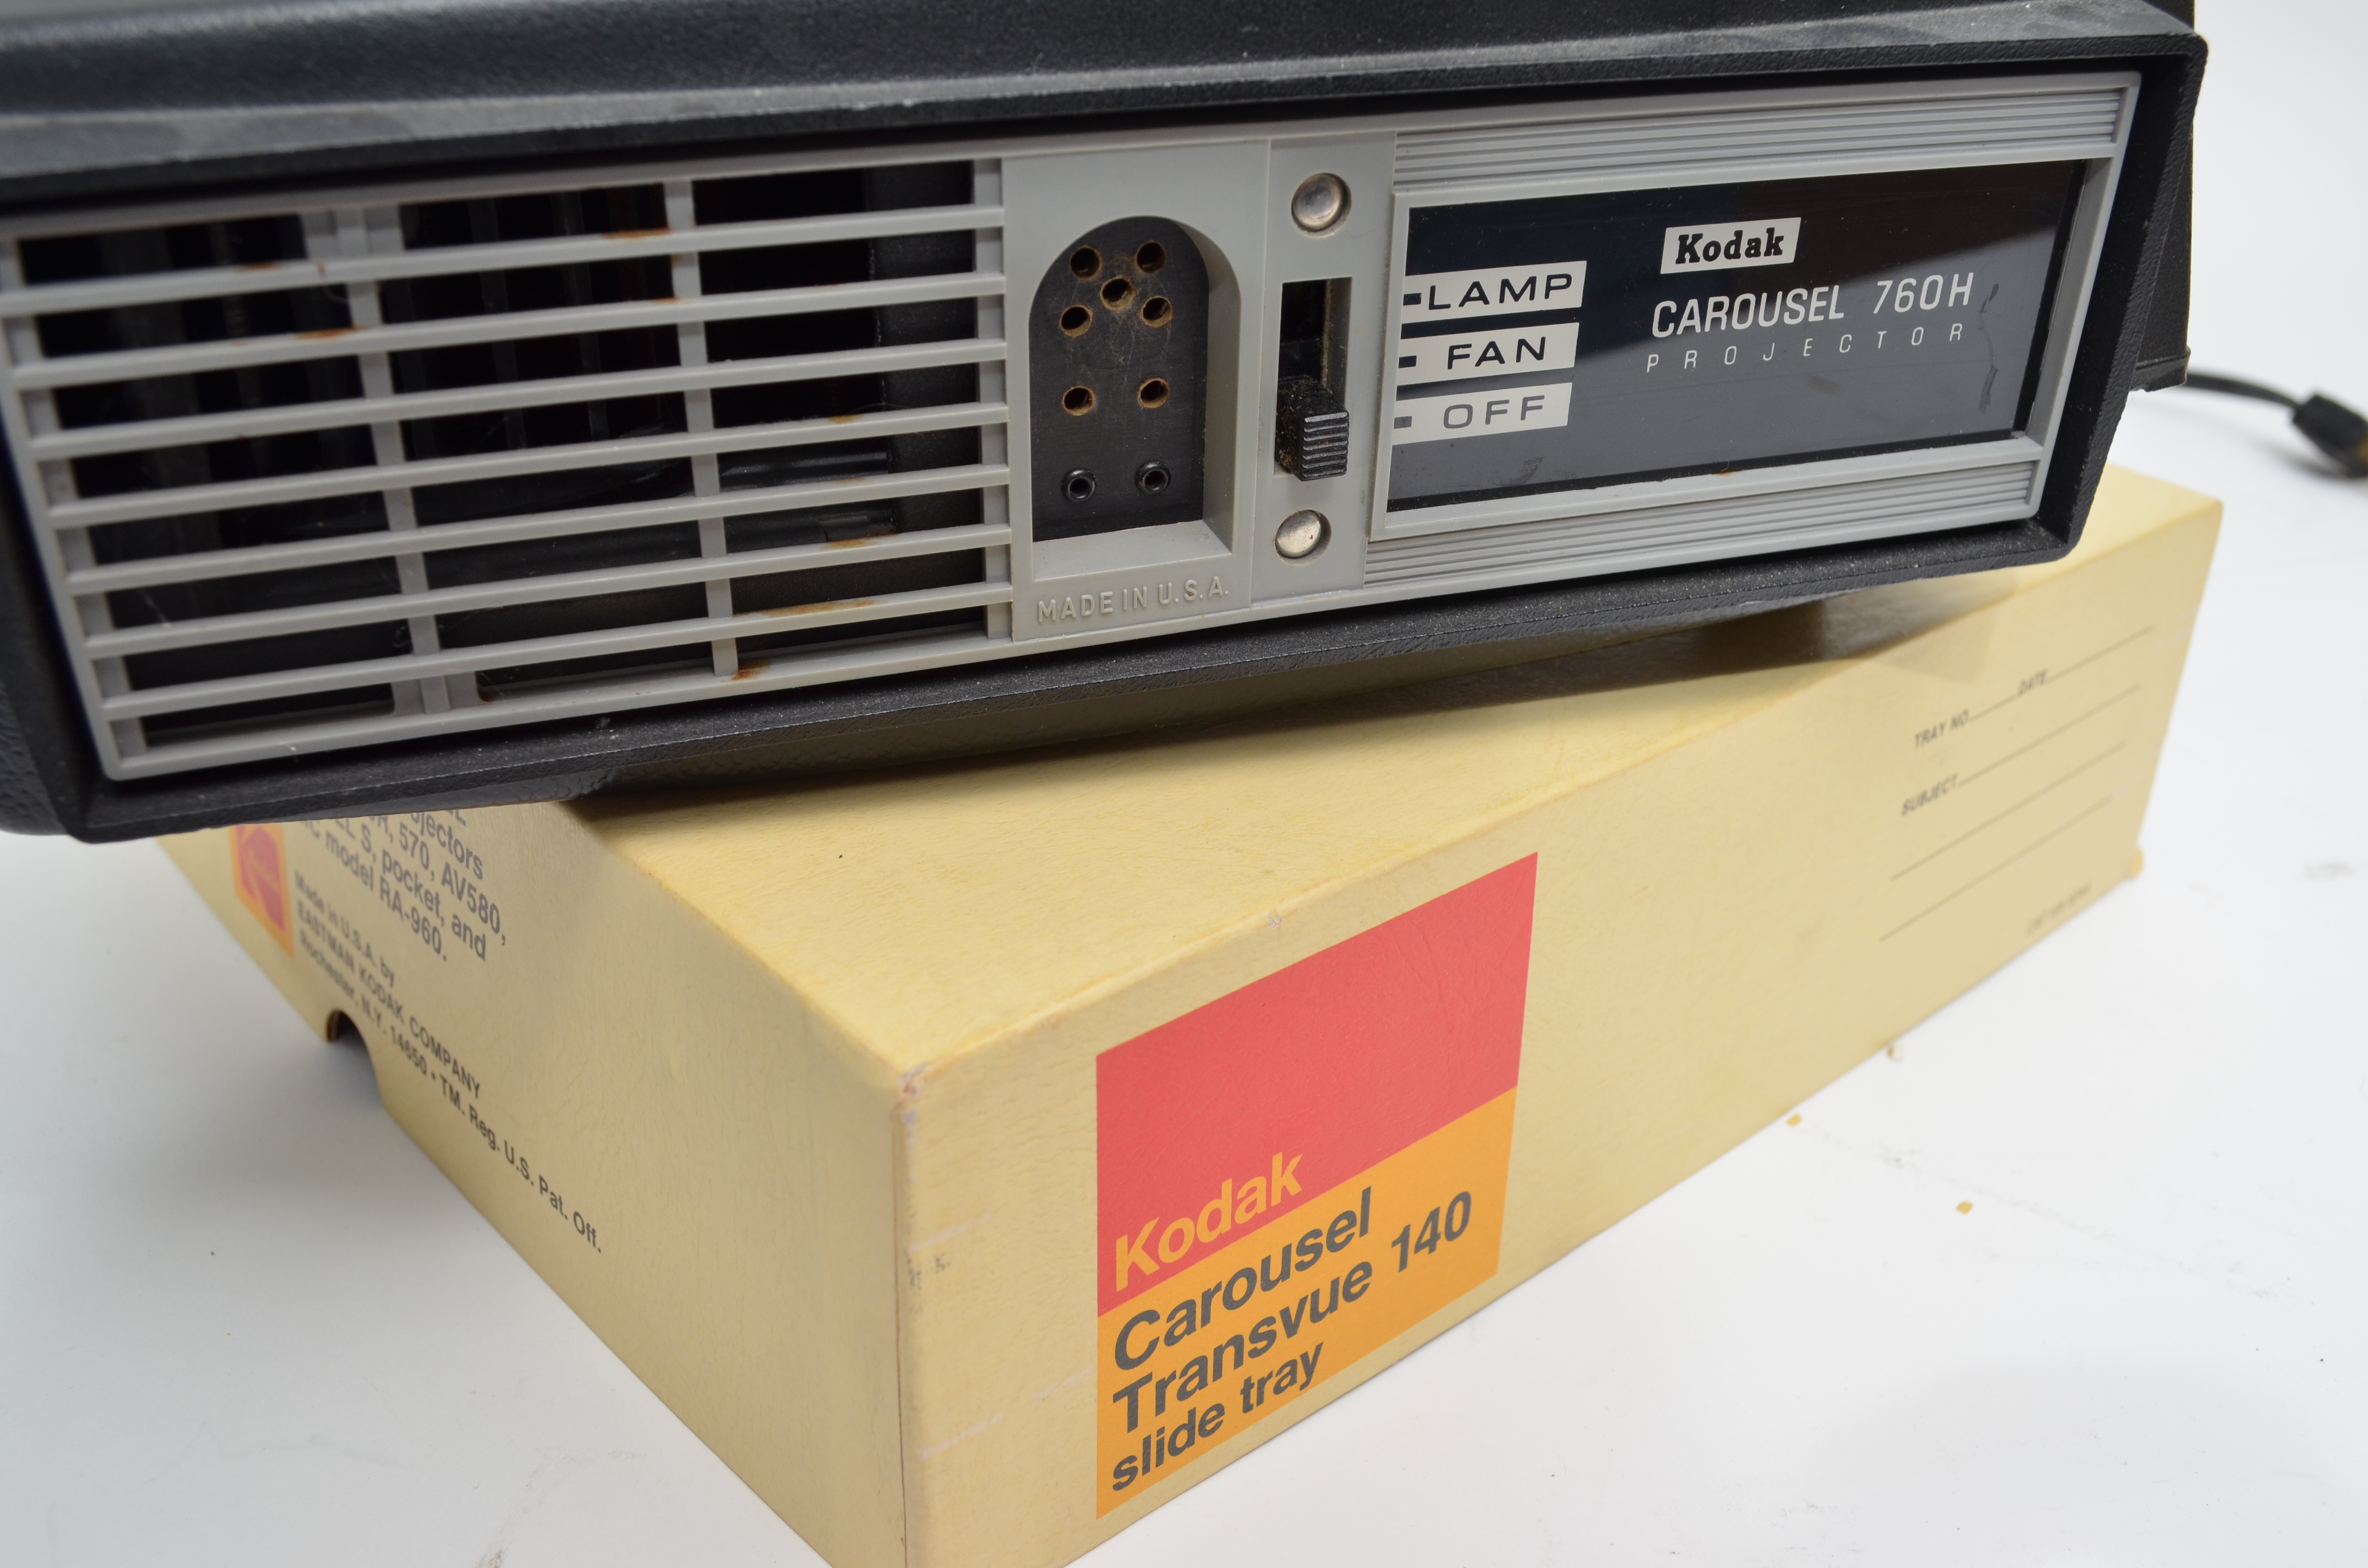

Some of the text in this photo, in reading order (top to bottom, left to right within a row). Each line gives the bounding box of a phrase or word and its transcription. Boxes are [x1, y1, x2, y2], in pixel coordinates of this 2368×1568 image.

[1675, 227, 1786, 265] Kodak
[1428, 273, 1574, 311] LAMP
[1652, 272, 1973, 338] CAROUSEL 760H
[1446, 335, 1547, 370] FAN
[1646, 322, 1963, 373] PROJECTOR
[1443, 394, 1546, 429] OFF
[1038, 576, 1229, 623] MADE IN U.S.A.
[1914, 720, 1946, 749] TRAY
[1901, 772, 1958, 817] SUBJECT
[325, 830, 374, 891] model
[382, 848, 445, 927] pocket,
[451, 914, 486, 962] and
[441, 862, 506, 946] AV580,
[297, 899, 481, 1099] EASTMAN KODAK COMPANY
[469, 1104, 501, 1152] Reg.
[505, 1139, 534, 1187] U.S.
[539, 1174, 568, 1221] Pat.
[573, 1211, 602, 1253] Off.
[1115, 1152, 1304, 1292] Kodak
[1114, 1186, 1372, 1371] Carousel
[1112, 1190, 1472, 1433] Transvue 140
[1112, 1341, 1324, 1491] slide tray
